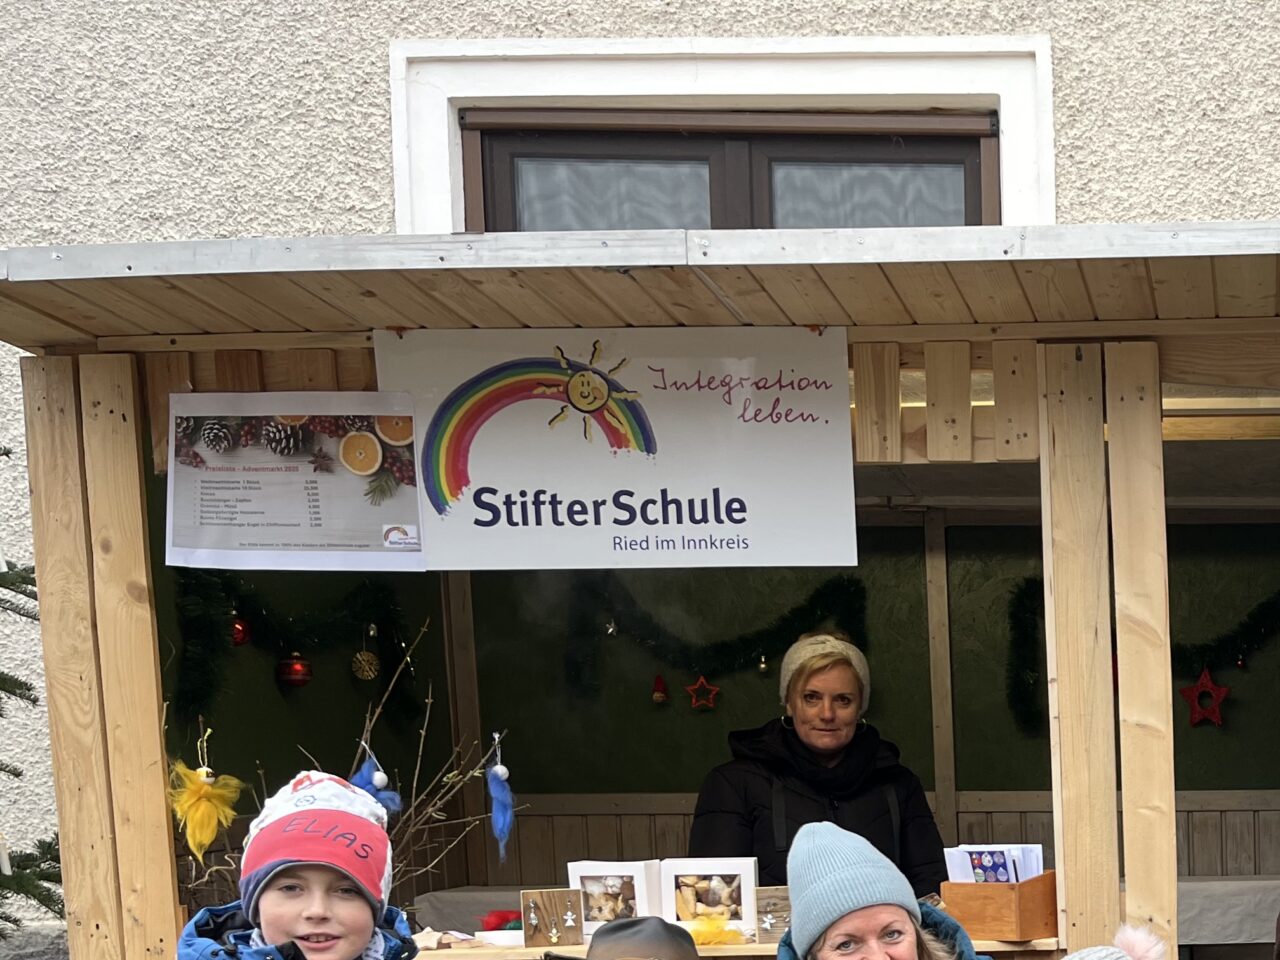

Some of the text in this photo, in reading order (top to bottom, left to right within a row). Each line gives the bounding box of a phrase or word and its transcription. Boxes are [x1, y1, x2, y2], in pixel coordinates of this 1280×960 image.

[648, 365, 833, 405] Integration
[737, 397, 829, 424] leben.
[613, 534, 749, 551] Ried im Innkreis
[282, 817, 374, 860] ELIAS
